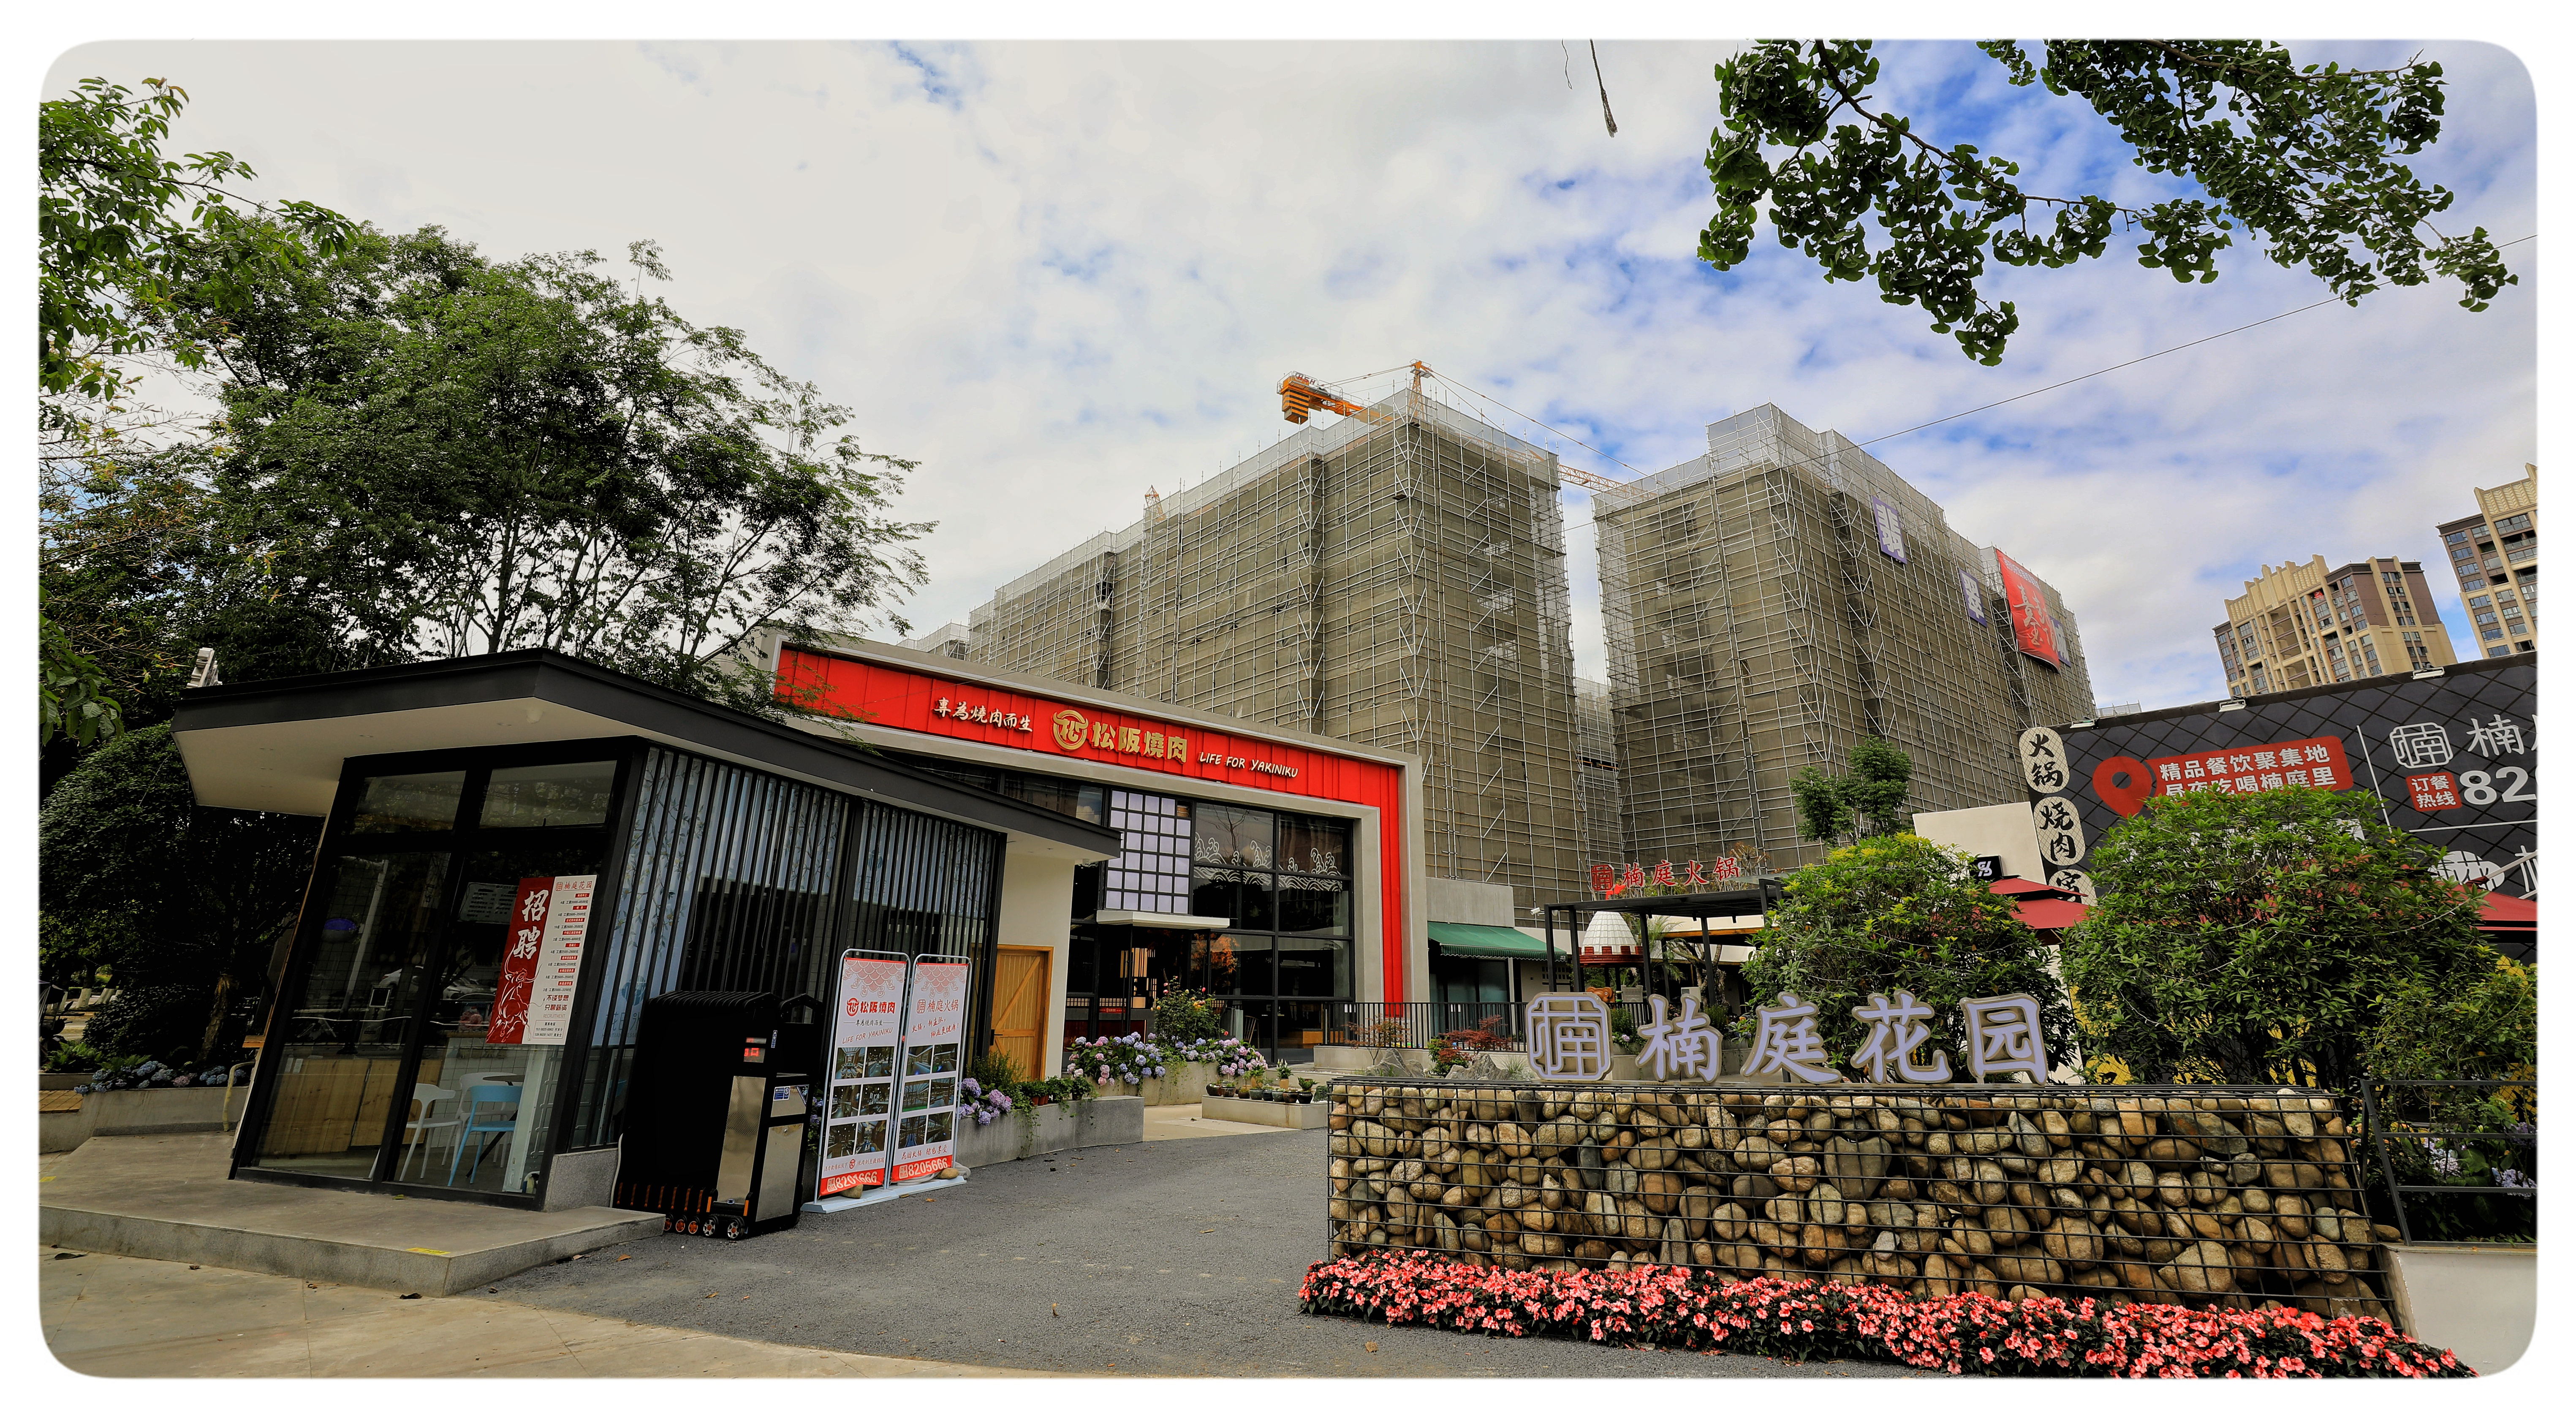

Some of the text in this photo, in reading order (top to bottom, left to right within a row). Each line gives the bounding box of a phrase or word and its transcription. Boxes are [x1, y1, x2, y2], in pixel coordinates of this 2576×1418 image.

[1091, 722, 1188, 763] 松阪燒肉
[2466, 714, 2537, 758] 楠
[1199, 752, 1299, 778] LIFE FOR YAKINIKU
[2029, 733, 2063, 787] 火锅
[2159, 744, 2331, 782] 精品餐饮聚集地
[2411, 776, 2450, 792] 订餐
[2417, 792, 2456, 808] 热线
[2040, 801, 2076, 862] 烧肉
[564, 880, 592, 890] 楠庭花园
[1622, 856, 1740, 889] 楠庭火锅
[513, 889, 549, 960] 招聘
[860, 1001, 896, 1014] 松阪燒肉
[927, 999, 959, 1013] 楠庭火锅
[842, 1027, 893, 1044] LIFE FOR YAKINIKU
[1636, 989, 2049, 1086] 楠庭花园
[836, 1171, 878, 1189] 8201666
[908, 1158, 948, 1176] 8205666
